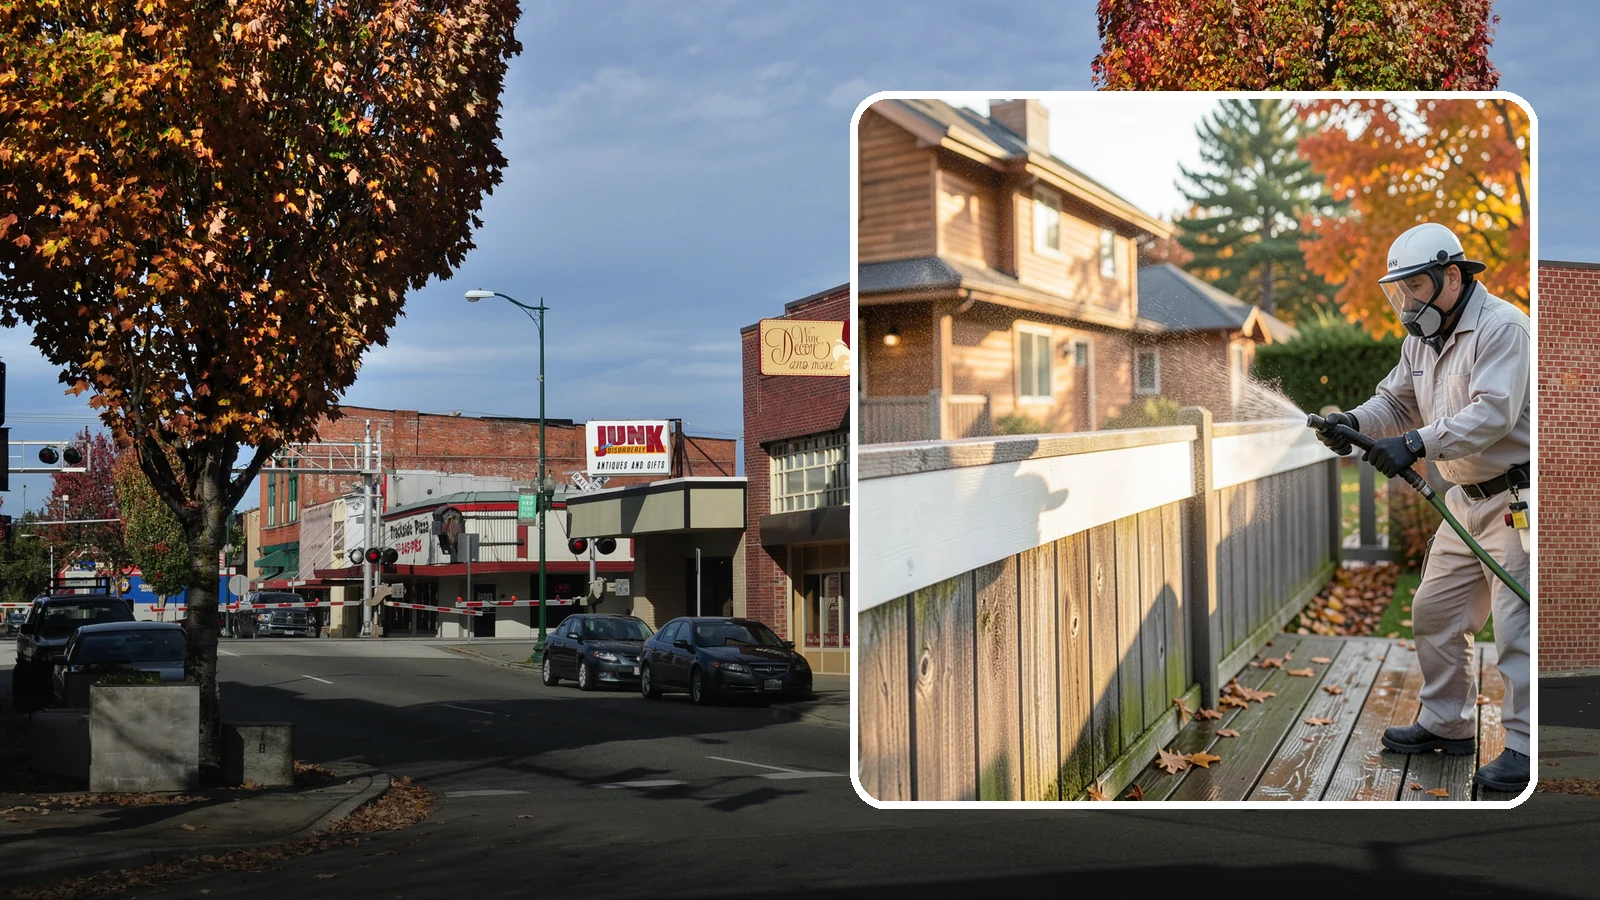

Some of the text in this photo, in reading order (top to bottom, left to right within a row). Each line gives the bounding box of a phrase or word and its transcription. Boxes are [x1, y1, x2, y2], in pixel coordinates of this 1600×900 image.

[764, 327, 831, 366] Decor
[595, 425, 665, 457] JUNK
[607, 446, 646, 454] DISORDERLY
[597, 460, 665, 470] ANTIQUES AND GIFTS
